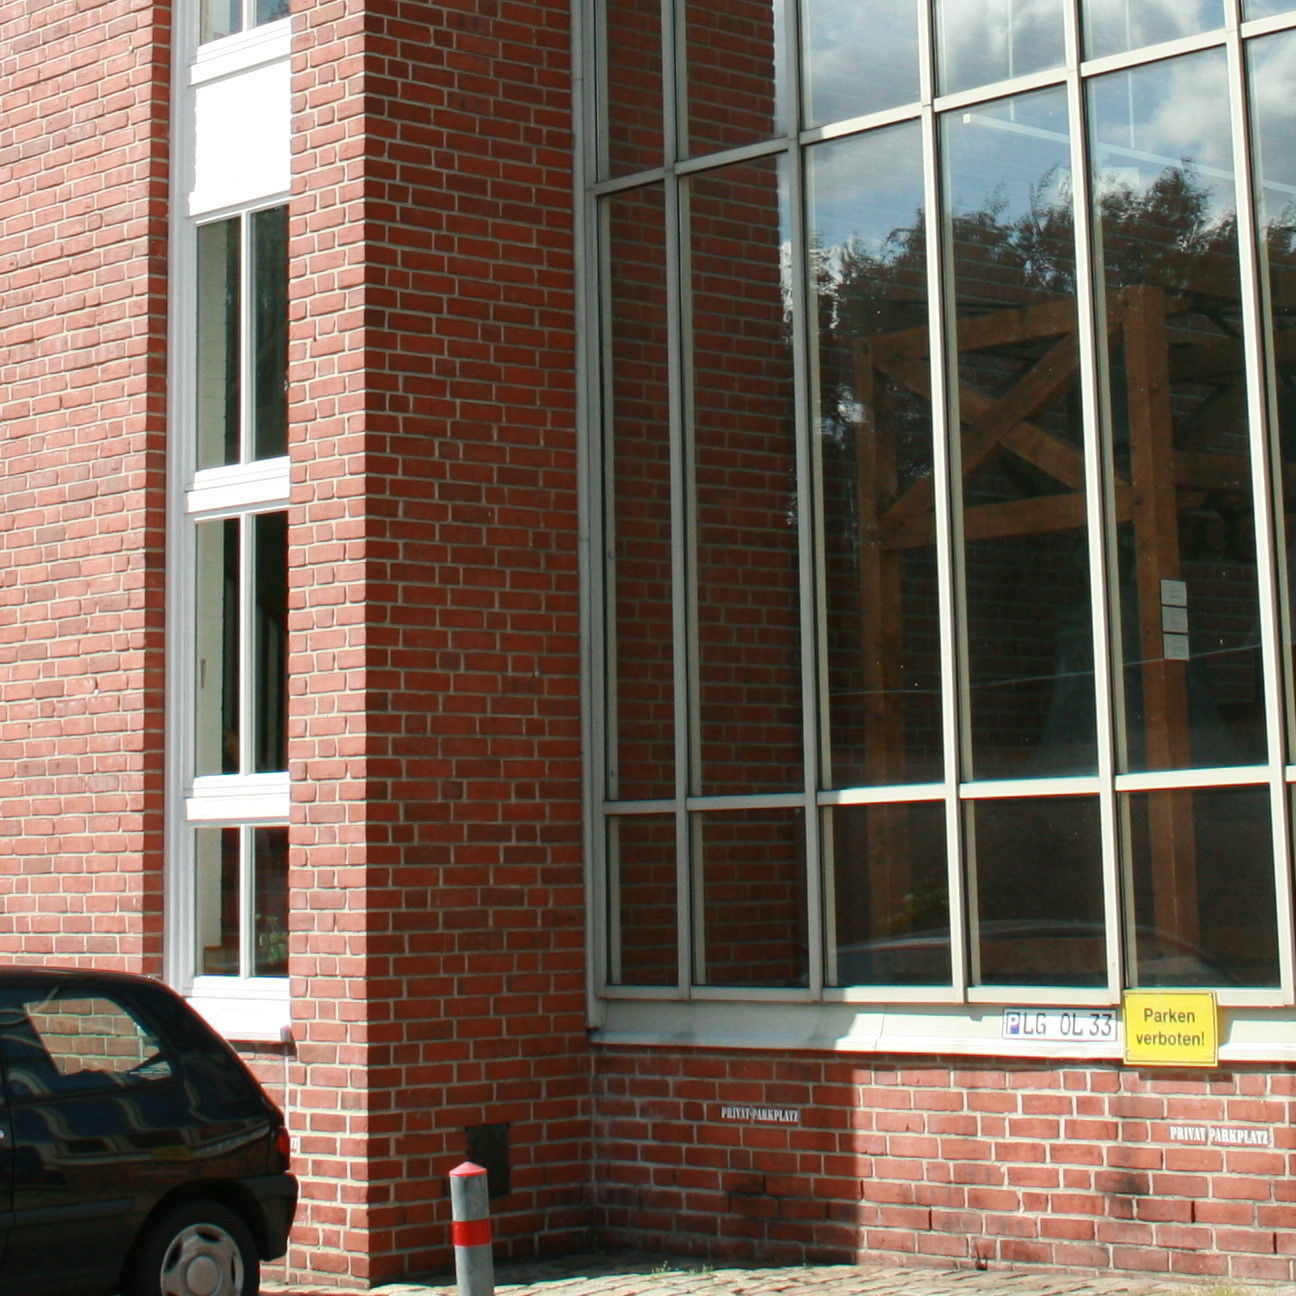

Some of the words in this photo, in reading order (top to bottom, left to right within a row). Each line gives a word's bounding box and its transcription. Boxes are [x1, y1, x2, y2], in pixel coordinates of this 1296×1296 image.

[1143, 1007, 1196, 1023] Parken
[1023, 1012, 1047, 1036] LG
[1060, 1013, 1084, 1037] OL
[1088, 1013, 1113, 1037] 33
[1135, 1030, 1206, 1047] verboten!
